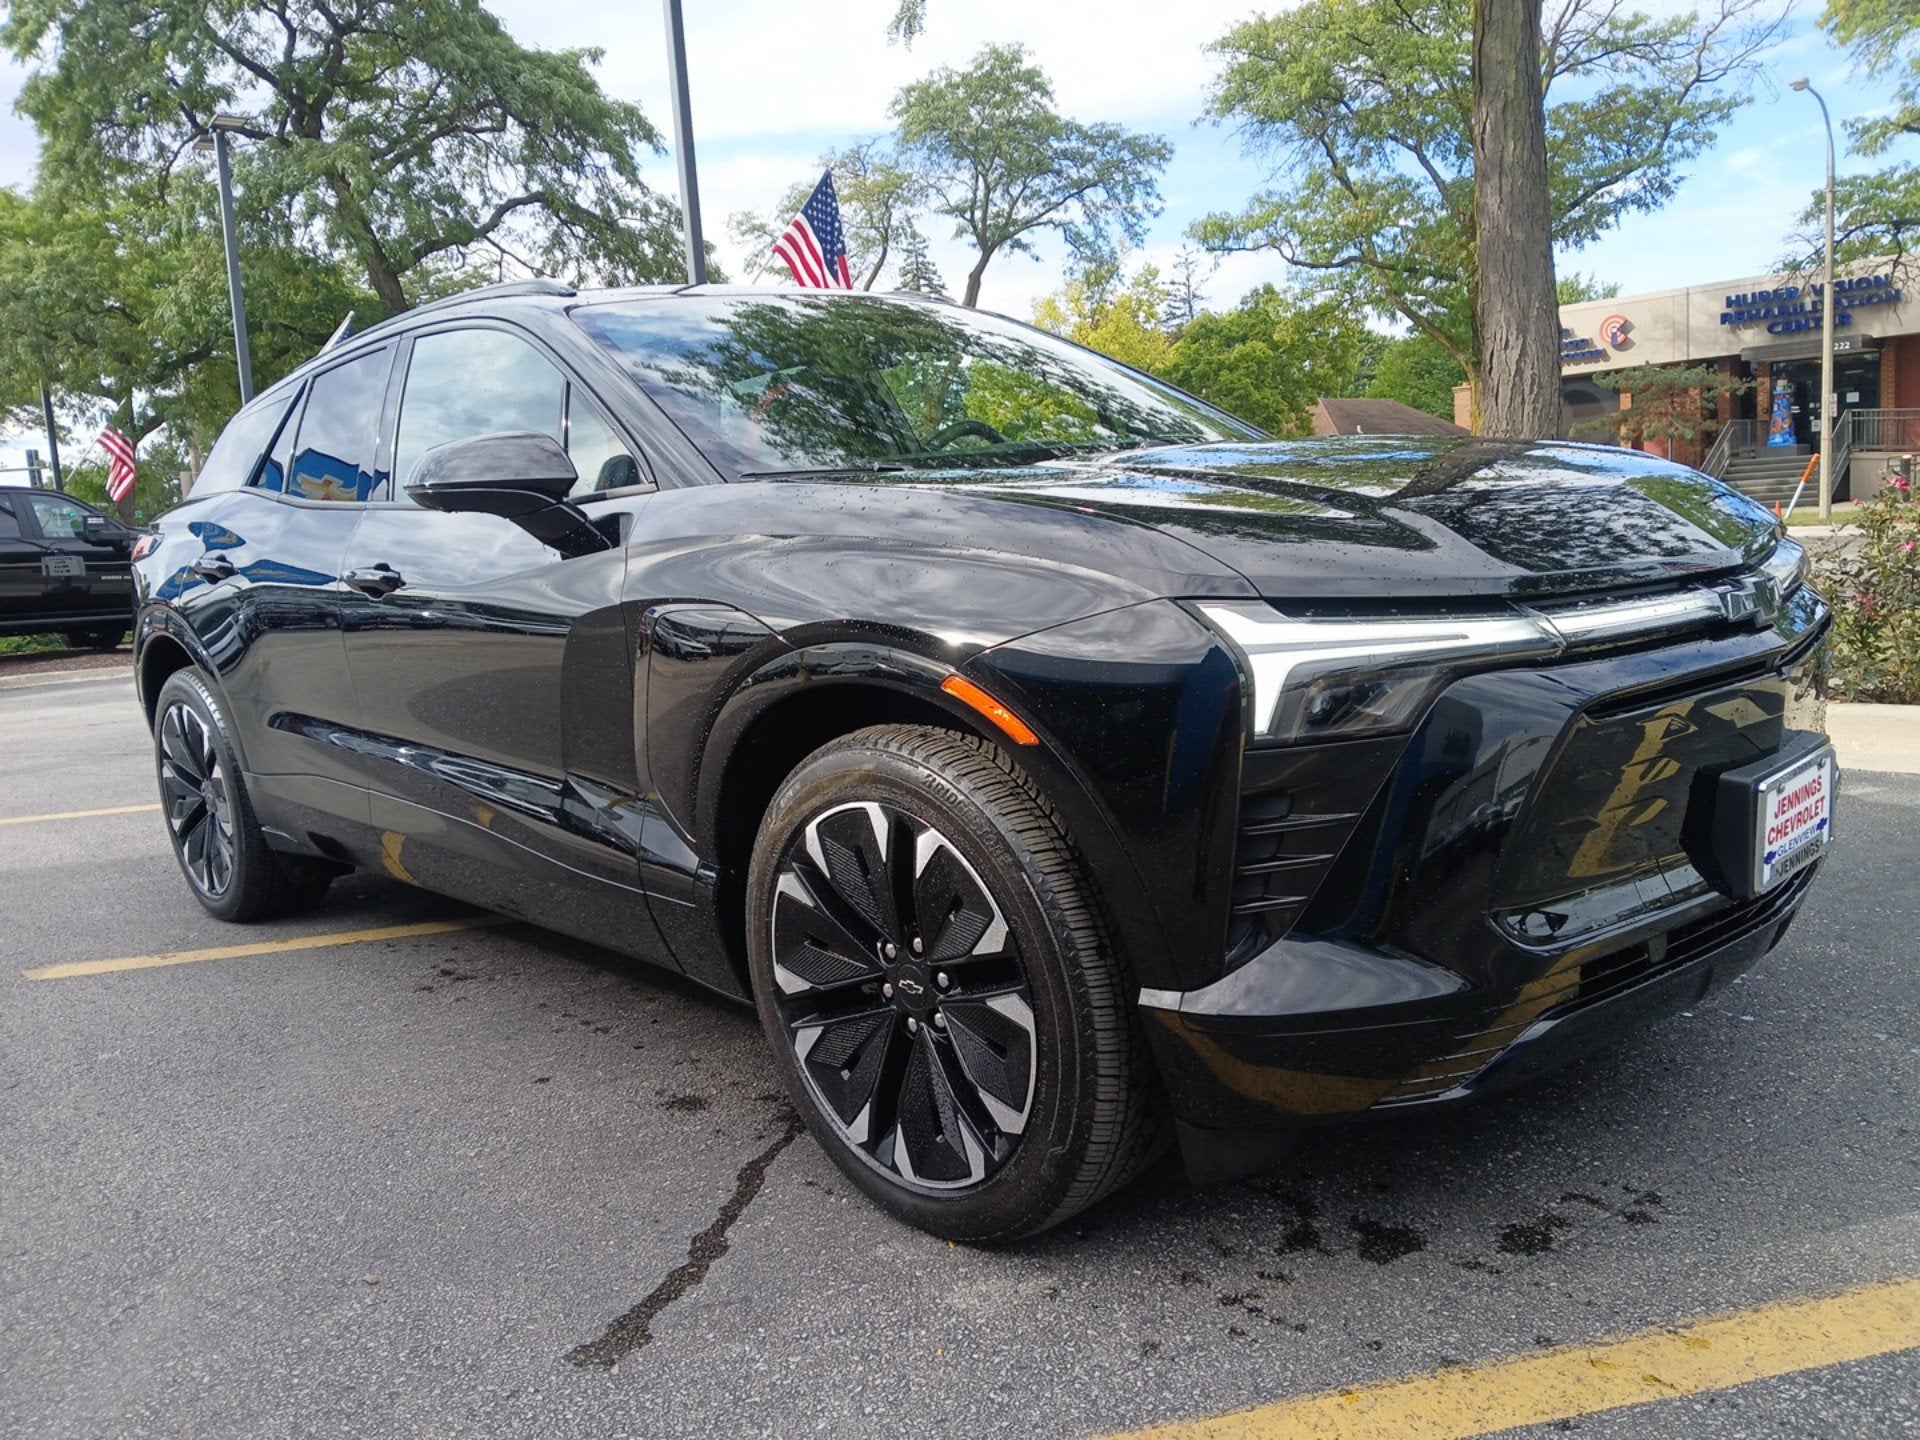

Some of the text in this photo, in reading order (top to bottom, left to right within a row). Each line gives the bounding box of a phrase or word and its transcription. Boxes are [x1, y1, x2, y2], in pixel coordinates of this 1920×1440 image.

[1725, 273, 1892, 308] HUBER VSION
[1767, 313, 1852, 334] CENTR
[1833, 342, 1850, 350] 222
[1774, 774, 1822, 819] JENNINGS
[1768, 796, 1825, 846] CHEVROLET
[1778, 824, 1817, 856] GLENVIEW
[1779, 840, 1821, 876] JENNINGS
